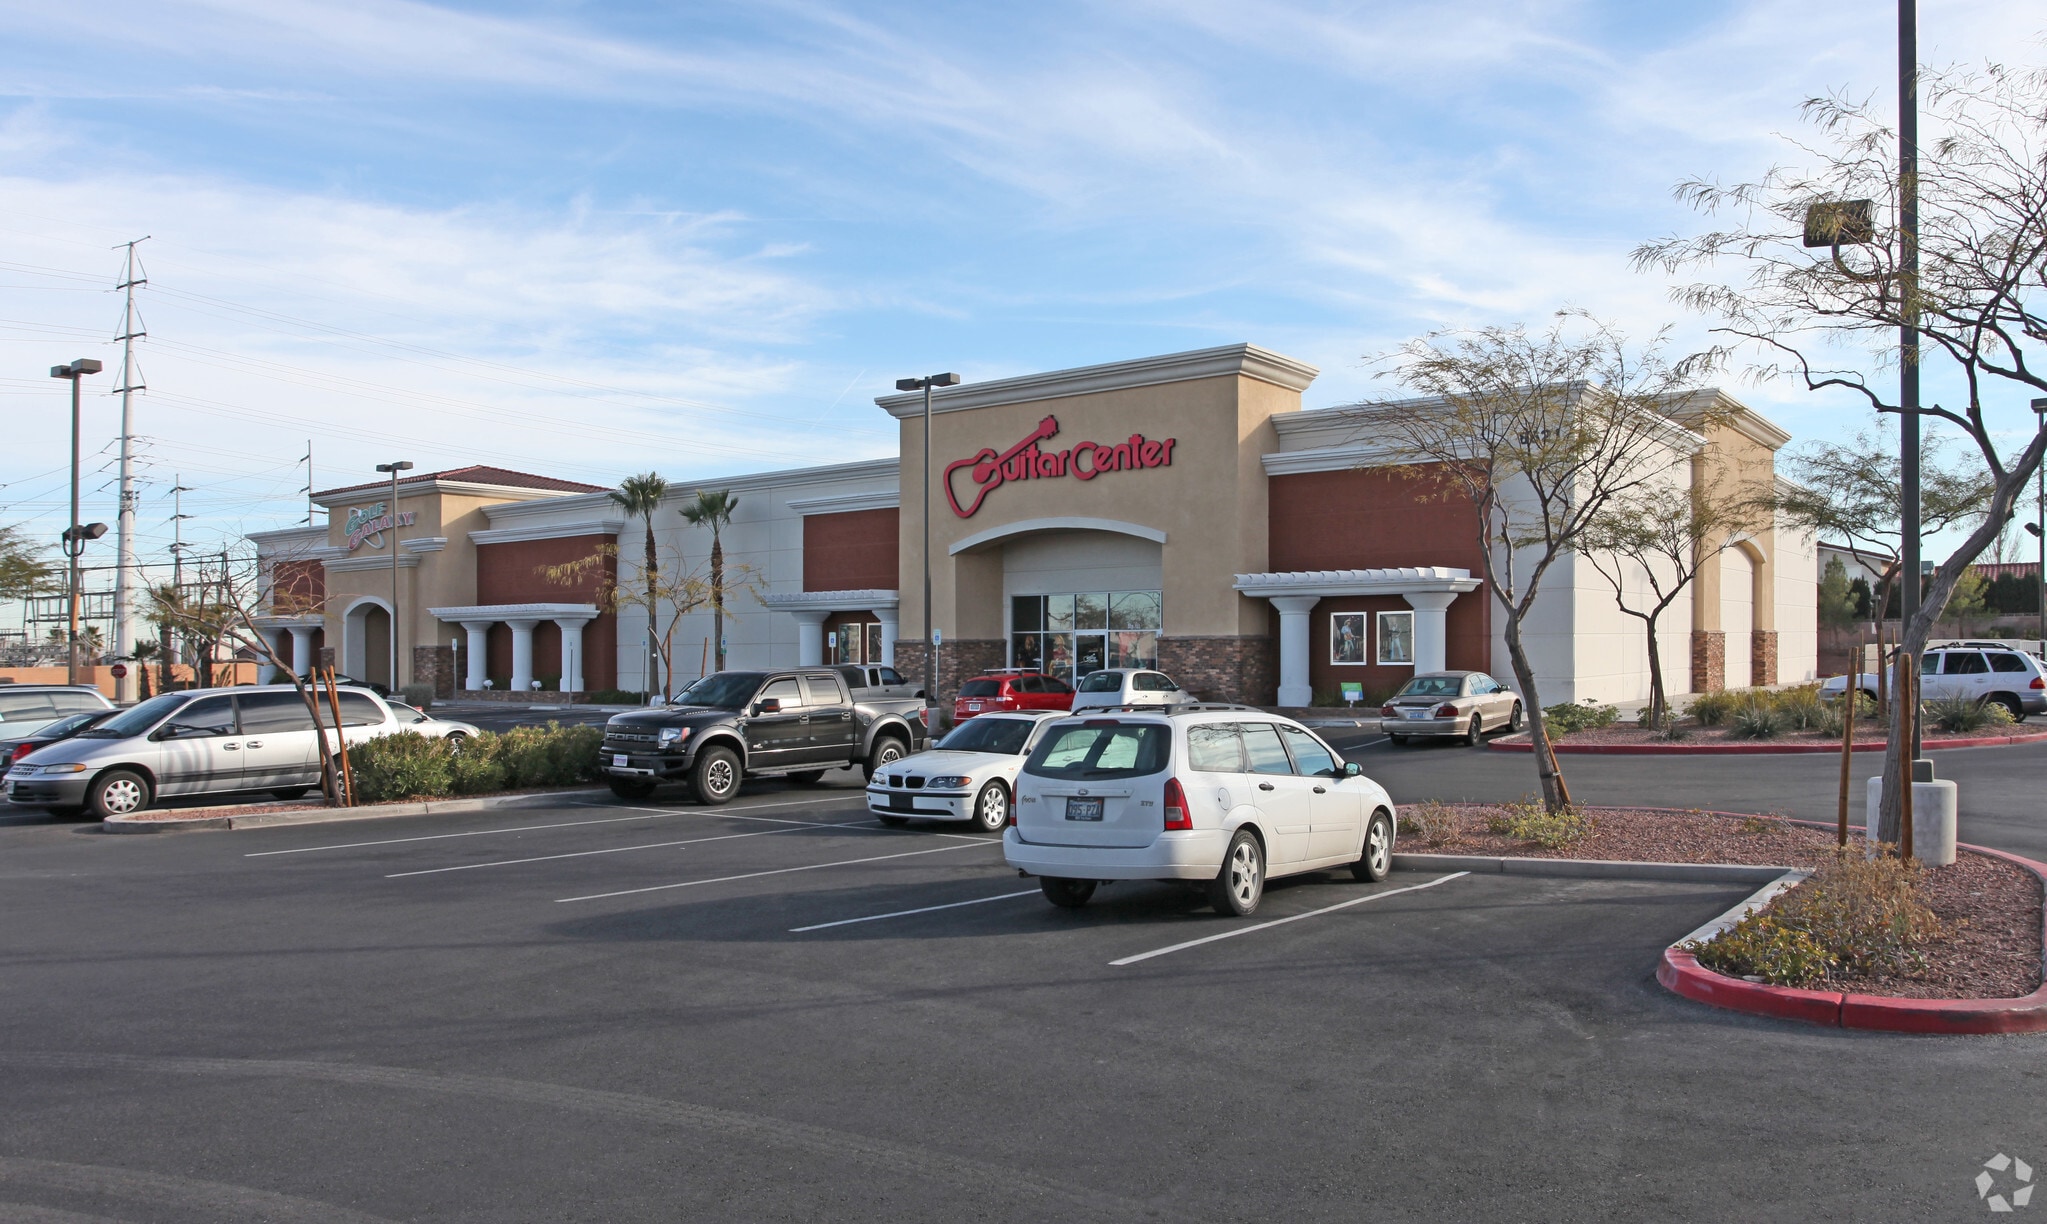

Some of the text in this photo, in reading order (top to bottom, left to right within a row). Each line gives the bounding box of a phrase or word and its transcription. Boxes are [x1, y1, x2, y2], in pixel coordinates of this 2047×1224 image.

[943, 415, 1176, 519] Guitar Center
[345, 502, 387, 536] GOLF
[606, 732, 658, 743] FORD
